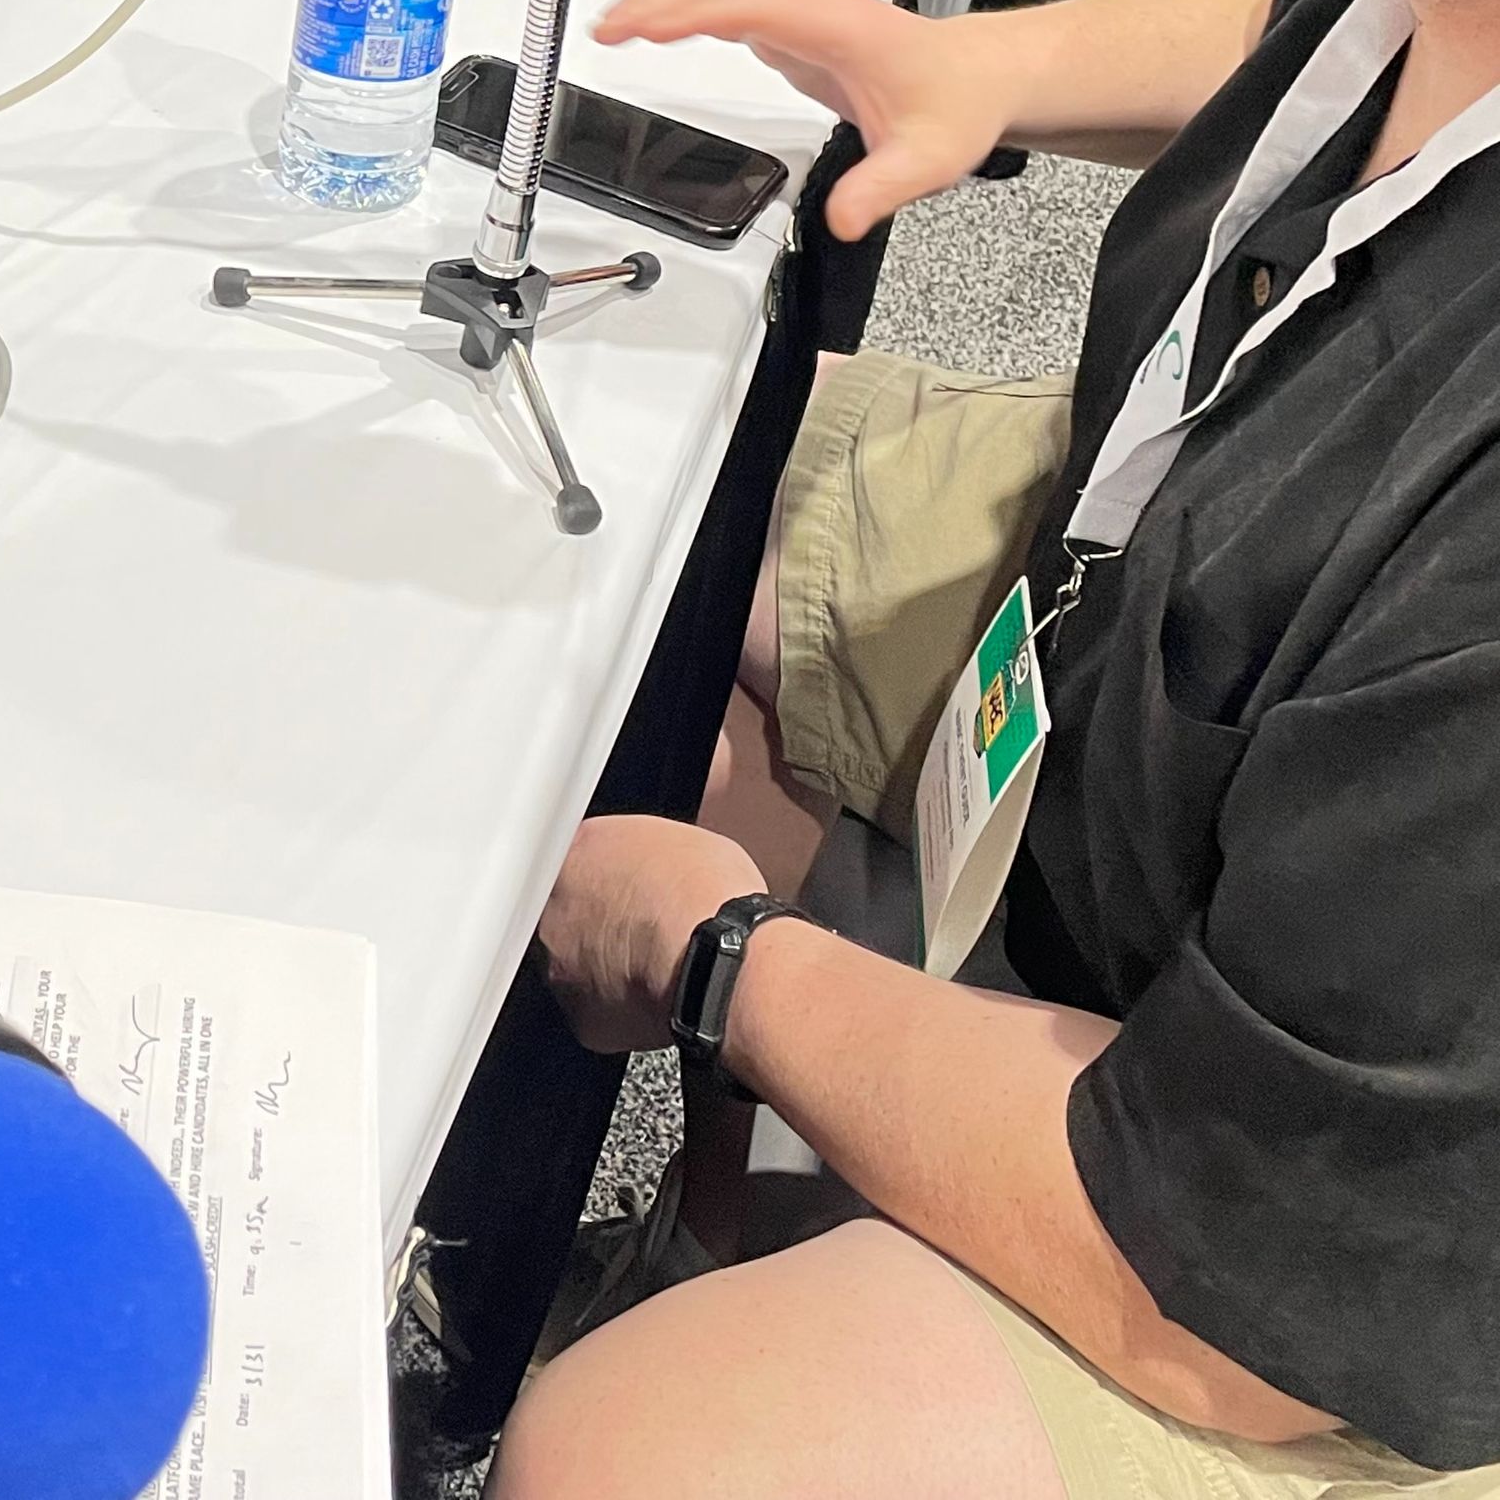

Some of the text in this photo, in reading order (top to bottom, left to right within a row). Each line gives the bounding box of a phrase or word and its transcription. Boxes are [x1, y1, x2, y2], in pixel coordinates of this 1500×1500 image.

[37, 969, 52, 998] YOUR
[53, 992, 67, 1021] YOUR
[181, 996, 196, 1034] HIRING
[50, 1022, 63, 1049] HELP
[200, 1015, 213, 1038] ONE
[69, 1035, 81, 1054] THE
[199, 1040, 211, 1053] IN
[176, 1036, 193, 1093] POWERFUL
[198, 1054, 211, 1073] ALL
[173, 1095, 188, 1125] THEIR
[190, 1146, 204, 1172] HIRE
[248, 1126, 263, 1182] Signature:
[188, 1173, 202, 1198] AND
[242, 1263, 257, 1297] Time:
[235, 1392, 250, 1427] Date:
